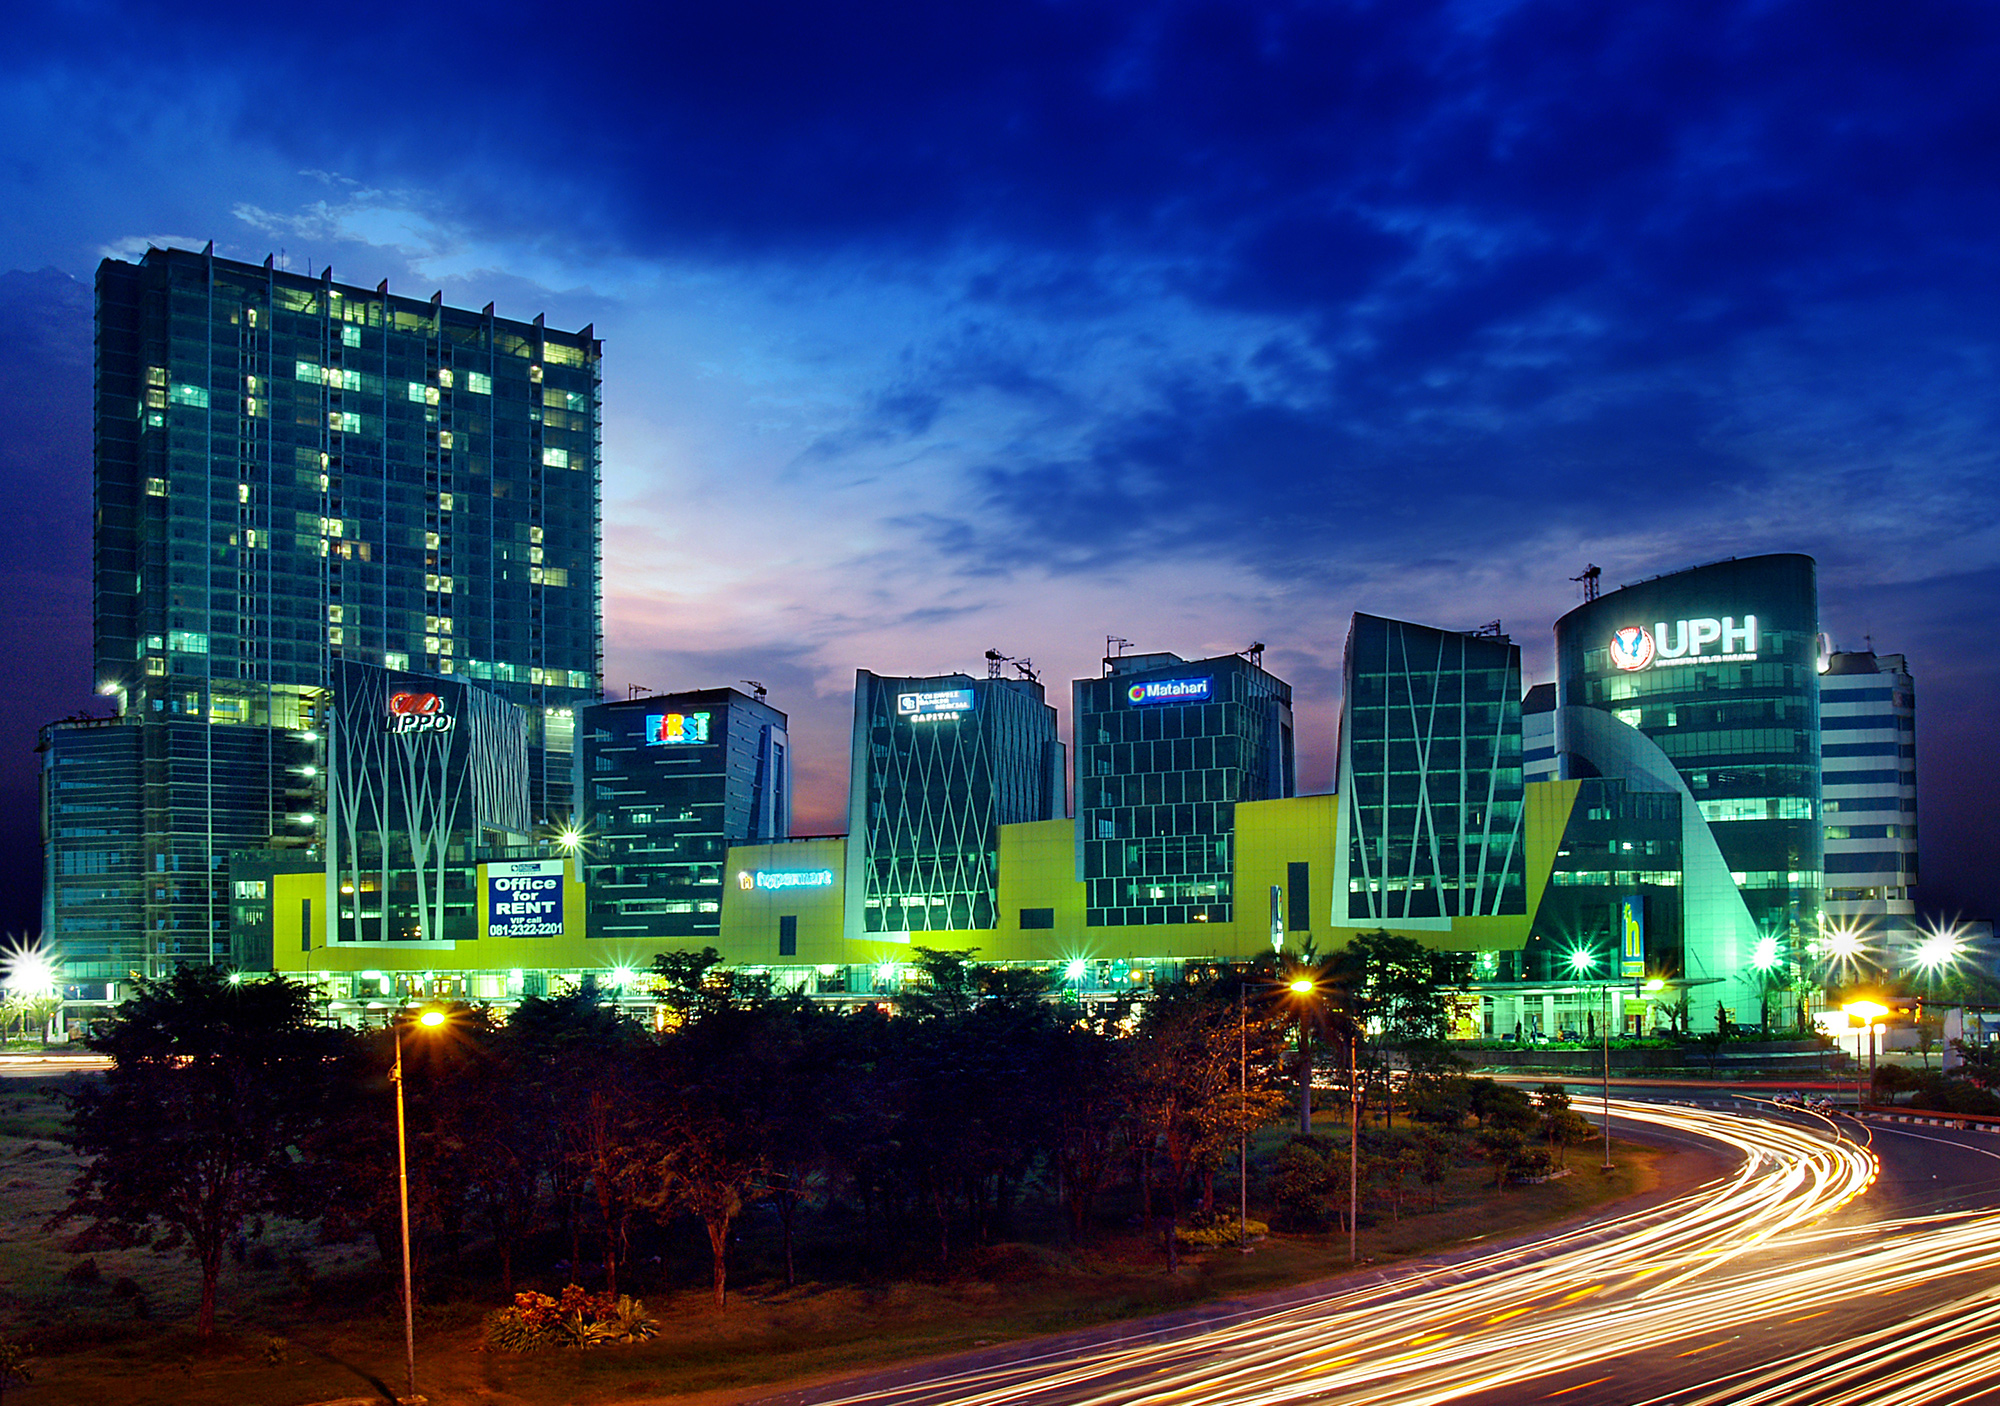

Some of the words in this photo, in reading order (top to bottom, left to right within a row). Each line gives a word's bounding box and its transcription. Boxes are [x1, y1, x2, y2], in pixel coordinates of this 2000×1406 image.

[1655, 614, 1757, 658] UPH
[1722, 653, 1757, 662] HARAPAN
[1146, 680, 1207, 697] Matahari
[911, 712, 959, 722] CAPITAL
[495, 878, 557, 891] Office
[512, 890, 539, 901] for
[496, 901, 556, 915] RENT
[526, 916, 542, 924] call
[489, 922, 563, 936] 081-2322-2201
